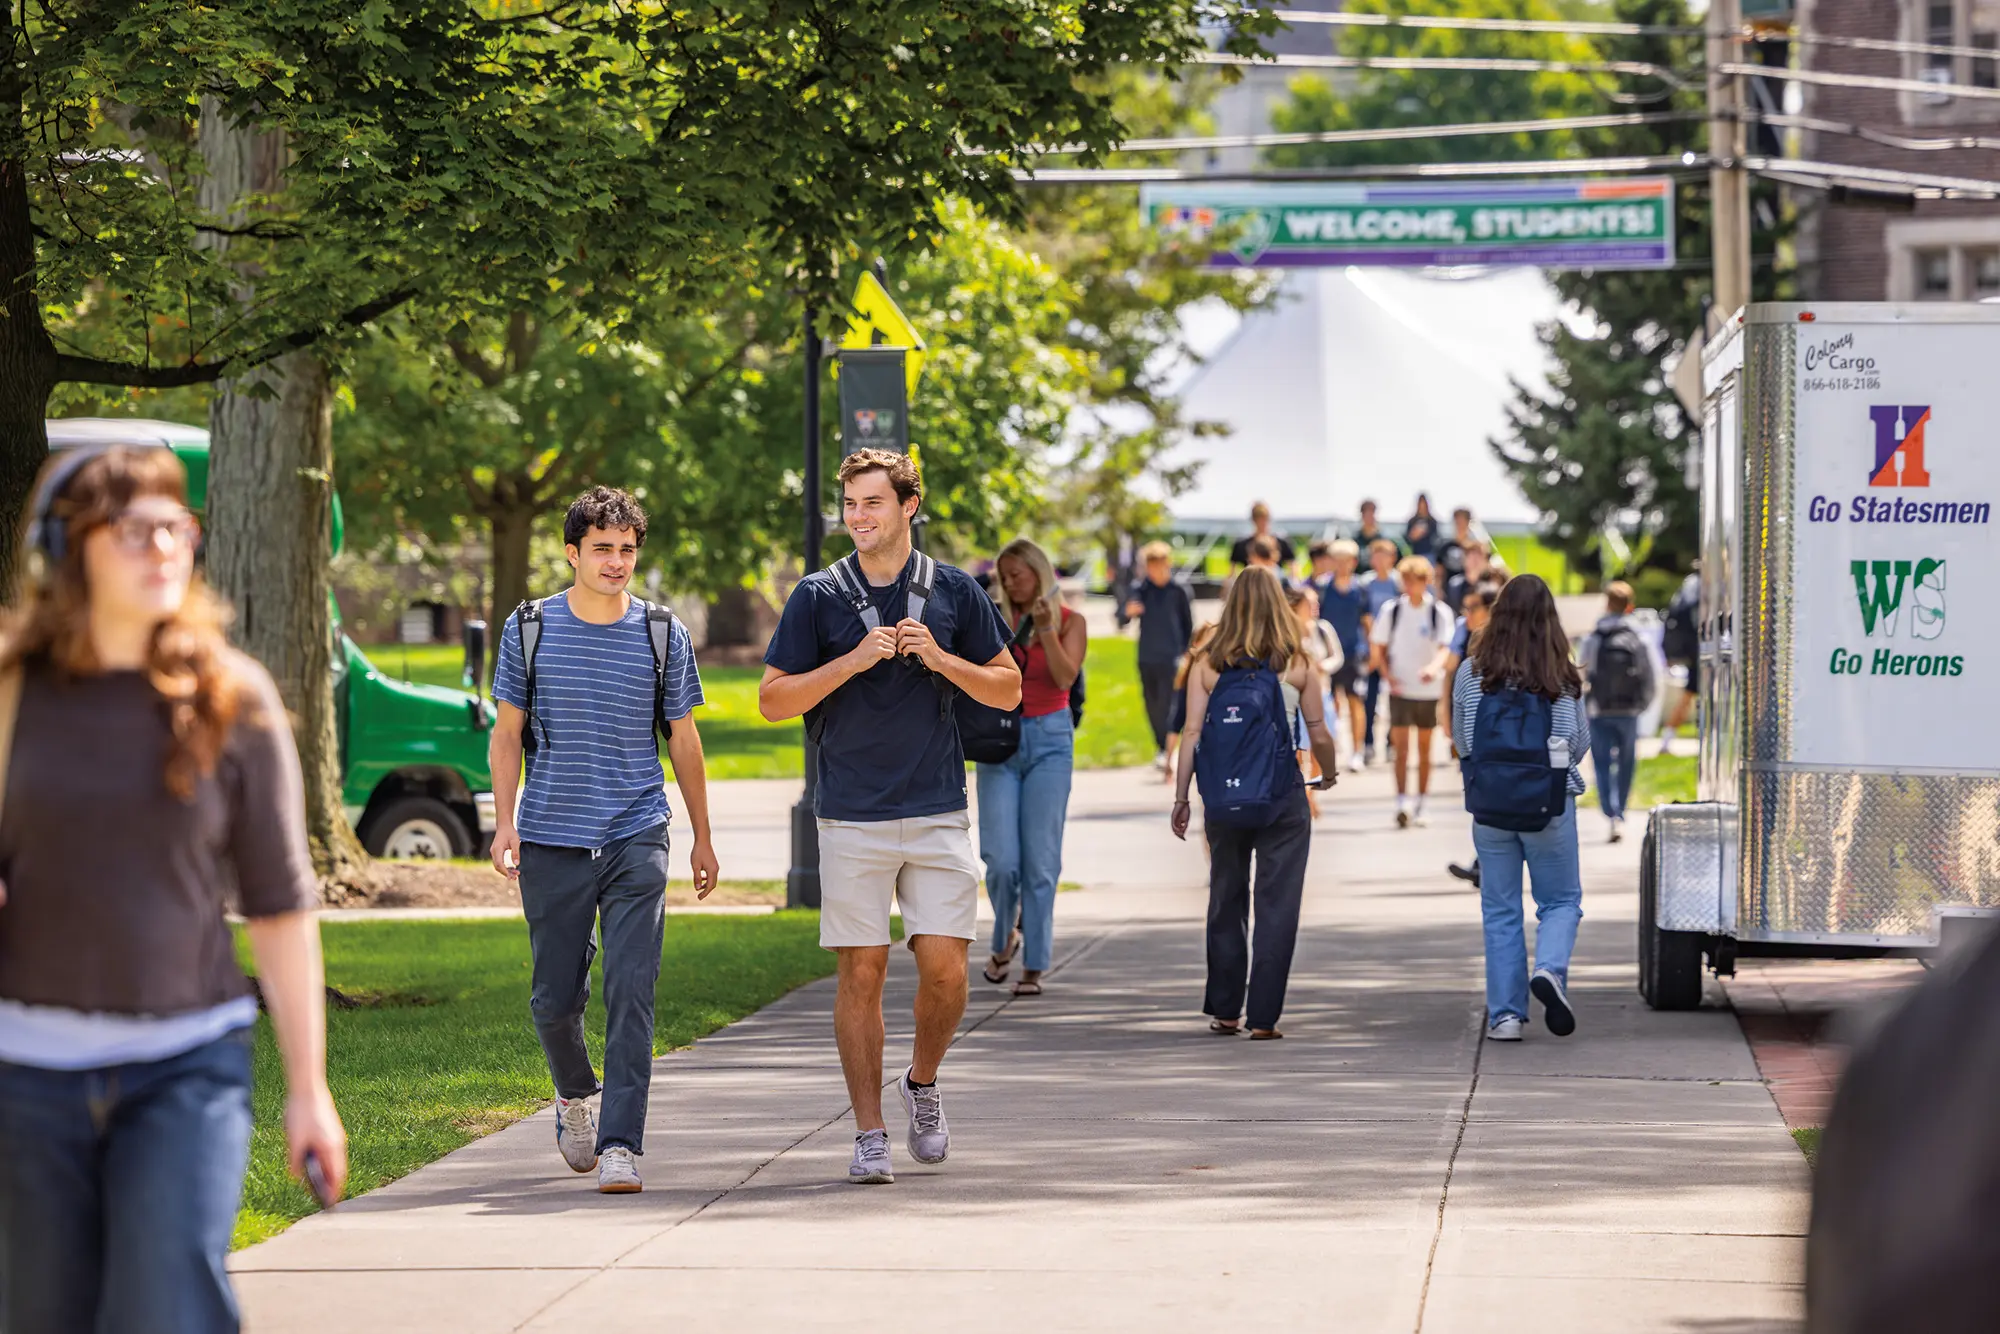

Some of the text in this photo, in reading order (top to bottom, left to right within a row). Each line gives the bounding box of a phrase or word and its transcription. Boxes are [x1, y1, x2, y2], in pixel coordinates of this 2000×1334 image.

[1284, 205, 1655, 244] WELCOME, STUDENTS!
[1805, 333, 1853, 371] Colony
[1829, 355, 1875, 372] Cargo
[1804, 377, 1881, 391] 866-618-2186
[1869, 405, 1931, 487] H
[1809, 495, 1990, 523] Go Statesmen
[1850, 557, 1946, 640] WS
[1829, 648, 1964, 676] Go Herons
